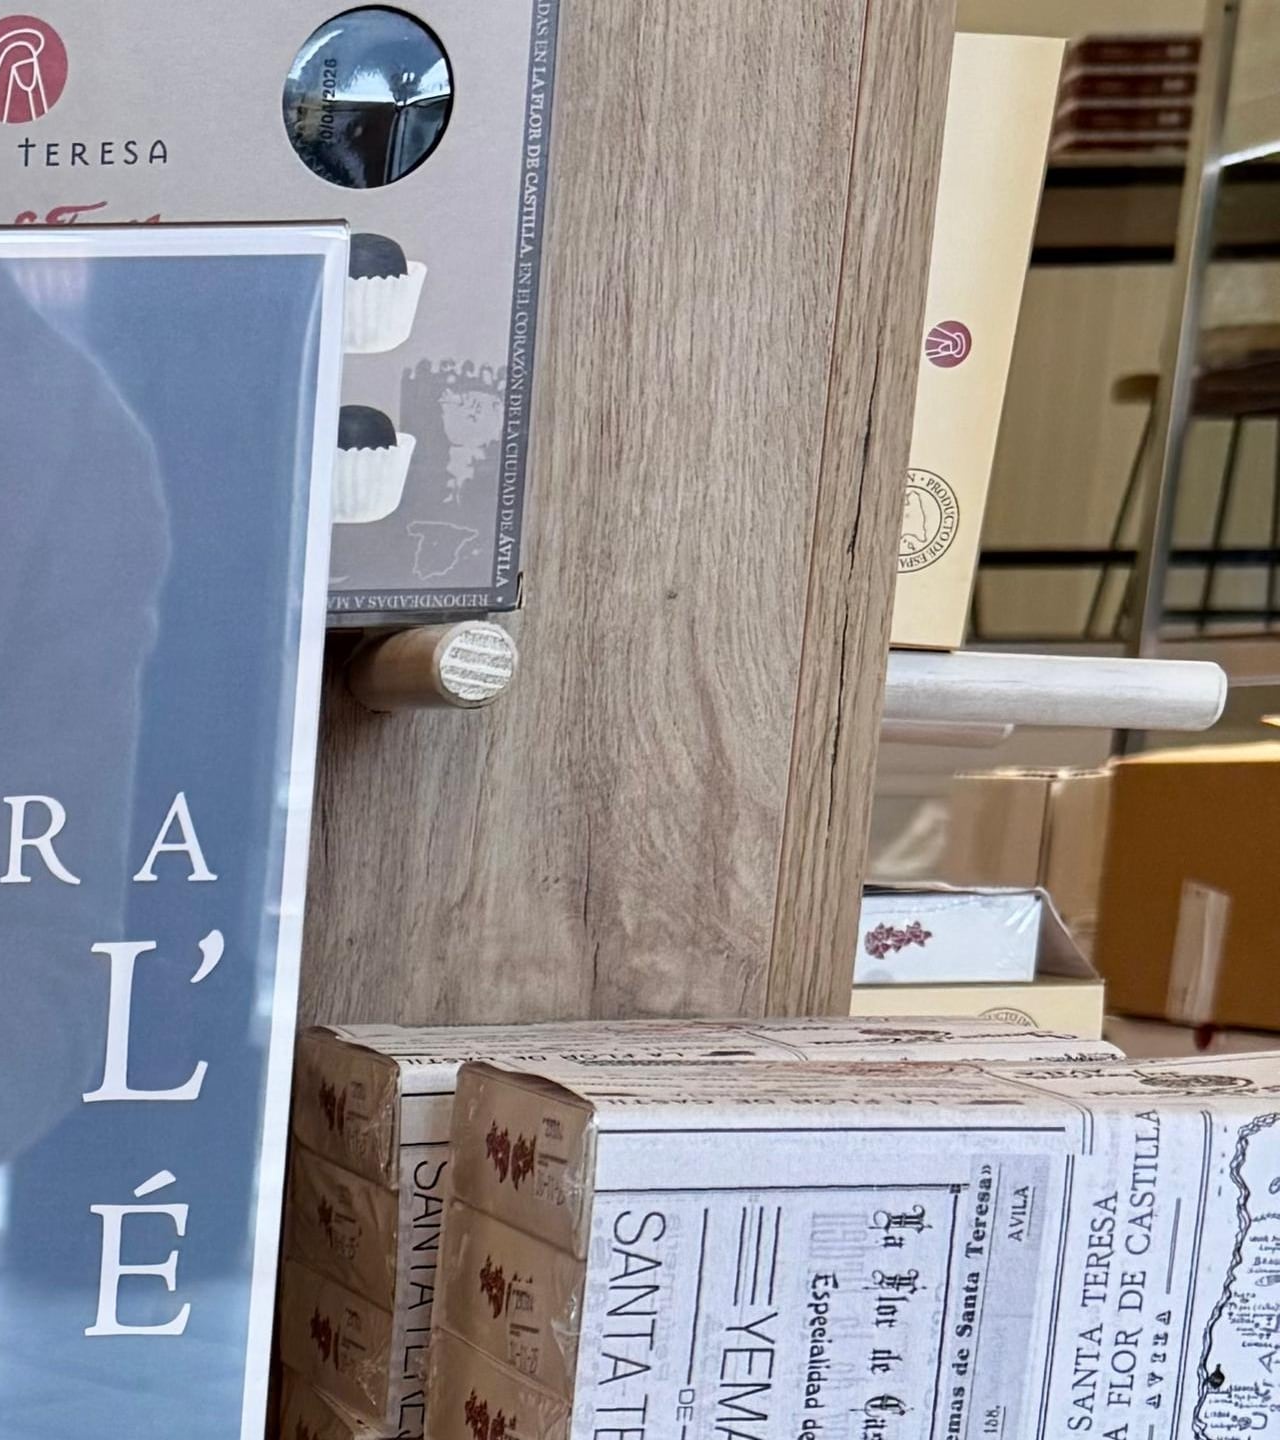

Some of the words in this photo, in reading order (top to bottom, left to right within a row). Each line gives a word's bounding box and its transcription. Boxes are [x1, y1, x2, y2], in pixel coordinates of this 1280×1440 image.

[531, 66, 547, 88] LA
[528, 90, 546, 140] FLOR
[17, 137, 168, 168] TERESA
[527, 145, 541, 169] DE
[517, 262, 532, 287] EN
[505, 418, 521, 438] LA
[508, 394, 523, 418] DE
[499, 441, 519, 507] CIUDAD
[498, 510, 514, 531] DE
[926, 478, 956, 542] PRODUCTO
[1125, 1108, 1162, 1258] CASTILLA
[1007, 1185, 1031, 1242] AVILA
[1082, 1189, 1120, 1312] TERESA
[597, 1210, 667, 1386] SANTA
[956, 1270, 981, 1338] Santa
[1118, 1270, 1147, 1313] DE
[804, 1272, 838, 1410] Especialidad
[870, 1347, 903, 1375] de
[951, 1349, 969, 1378] de
[1068, 1322, 1104, 1432] SANTA
[1107, 1326, 1144, 1409] FLOR
[675, 1388, 696, 1422] DE
